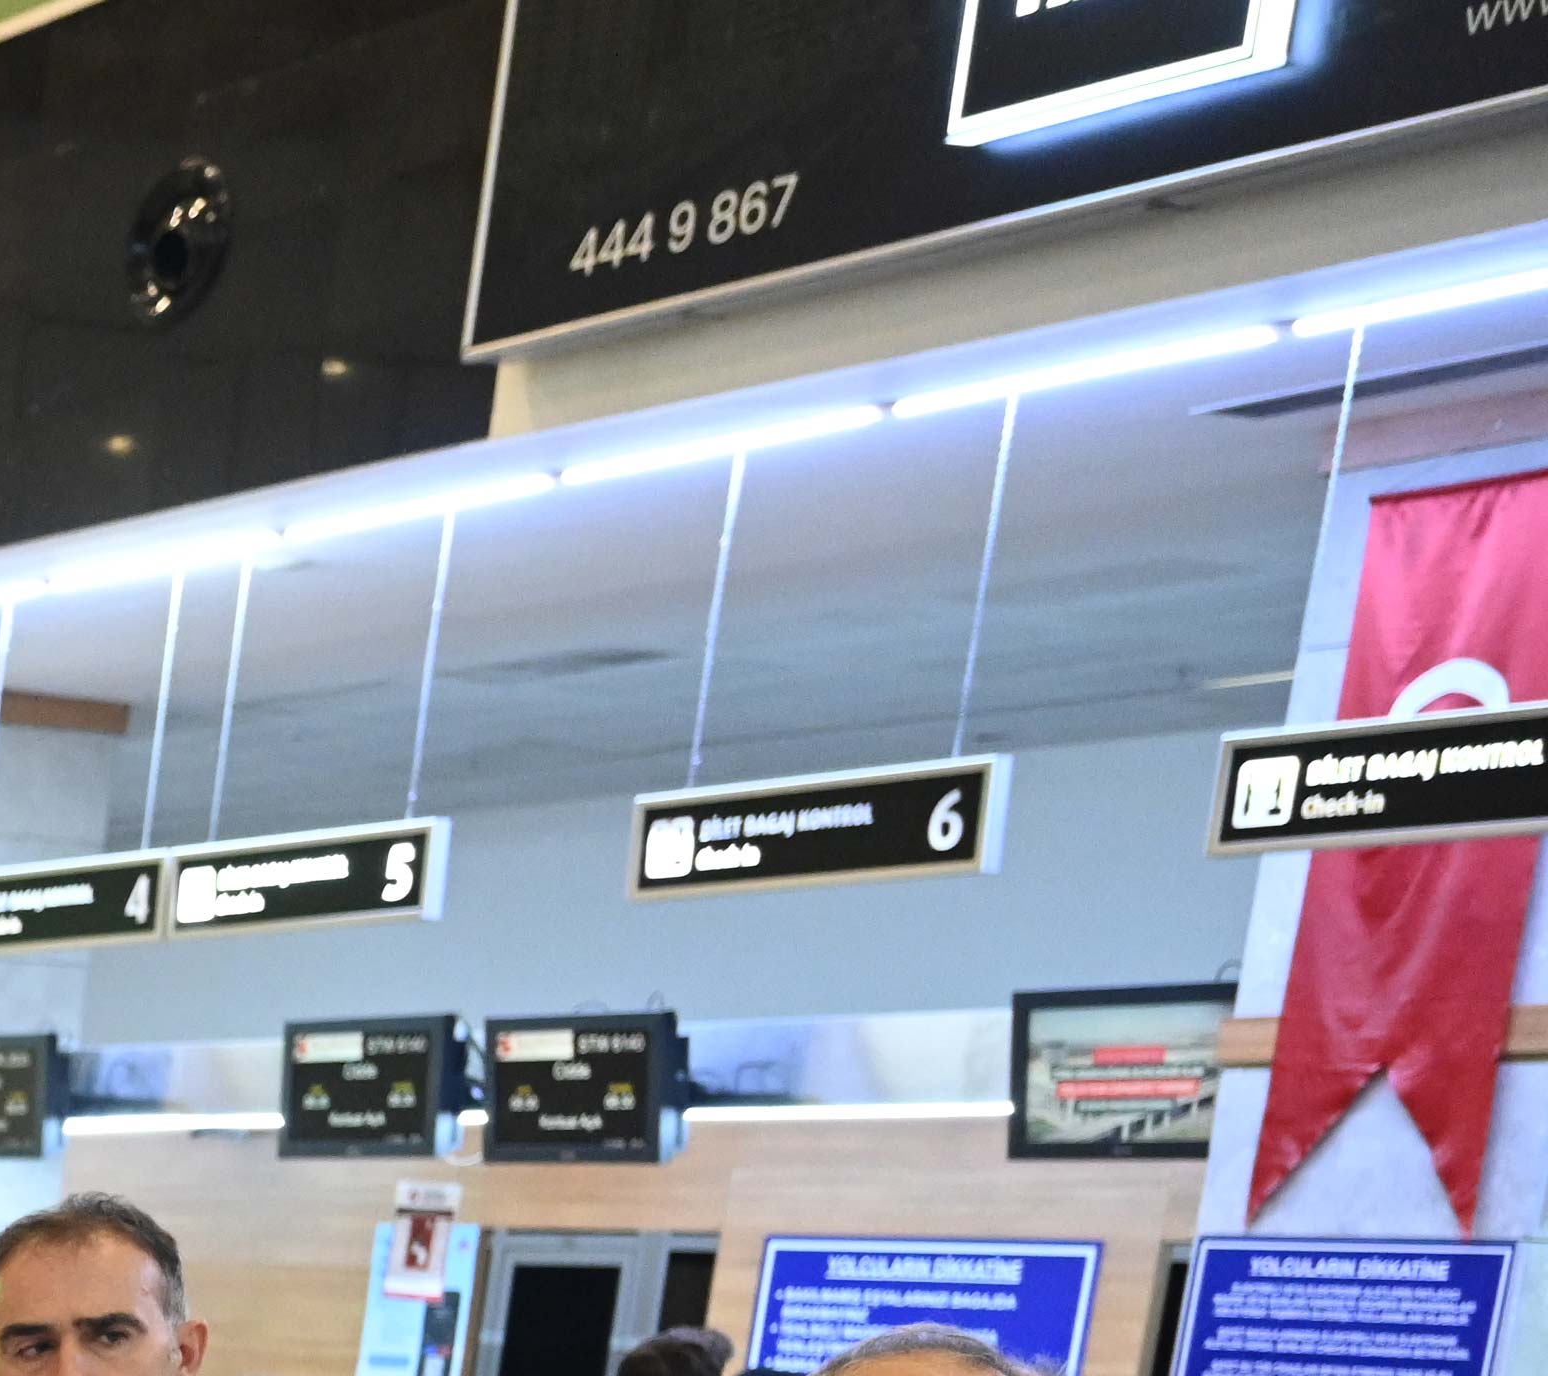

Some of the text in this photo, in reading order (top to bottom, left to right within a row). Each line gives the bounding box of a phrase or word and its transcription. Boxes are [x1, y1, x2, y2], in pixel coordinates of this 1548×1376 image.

[569, 170, 799, 277] 444 9 867
[926, 787, 965, 852] 6
[124, 872, 151, 925] 4
[381, 842, 416, 903] 5
